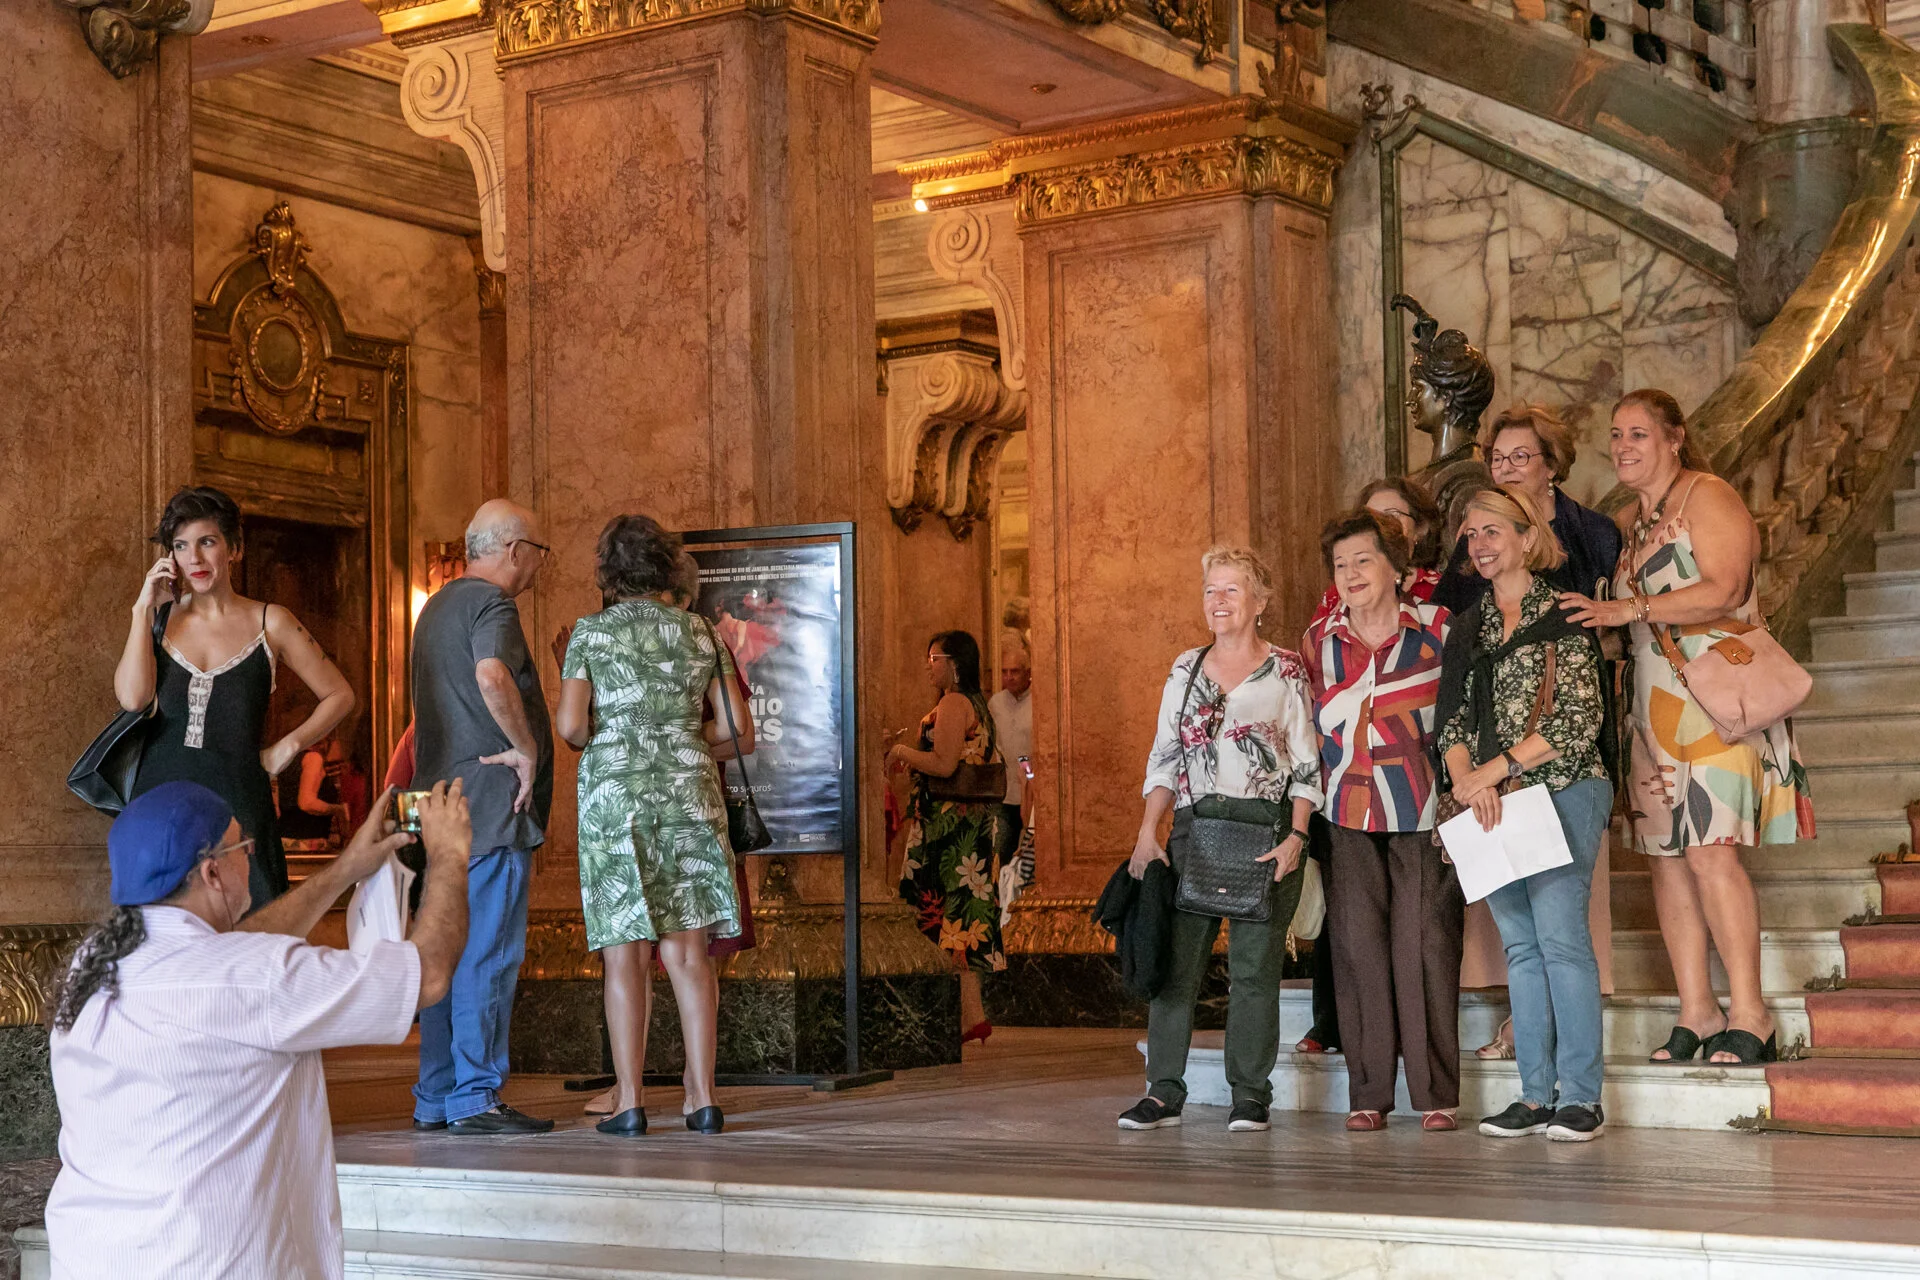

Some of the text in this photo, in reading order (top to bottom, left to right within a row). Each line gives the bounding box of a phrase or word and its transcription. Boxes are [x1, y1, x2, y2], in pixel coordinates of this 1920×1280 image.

[749, 682, 765, 696] ÍA
[748, 698, 783, 716] NIO
[753, 718, 783, 742] ES
[740, 783, 772, 794] sguros
